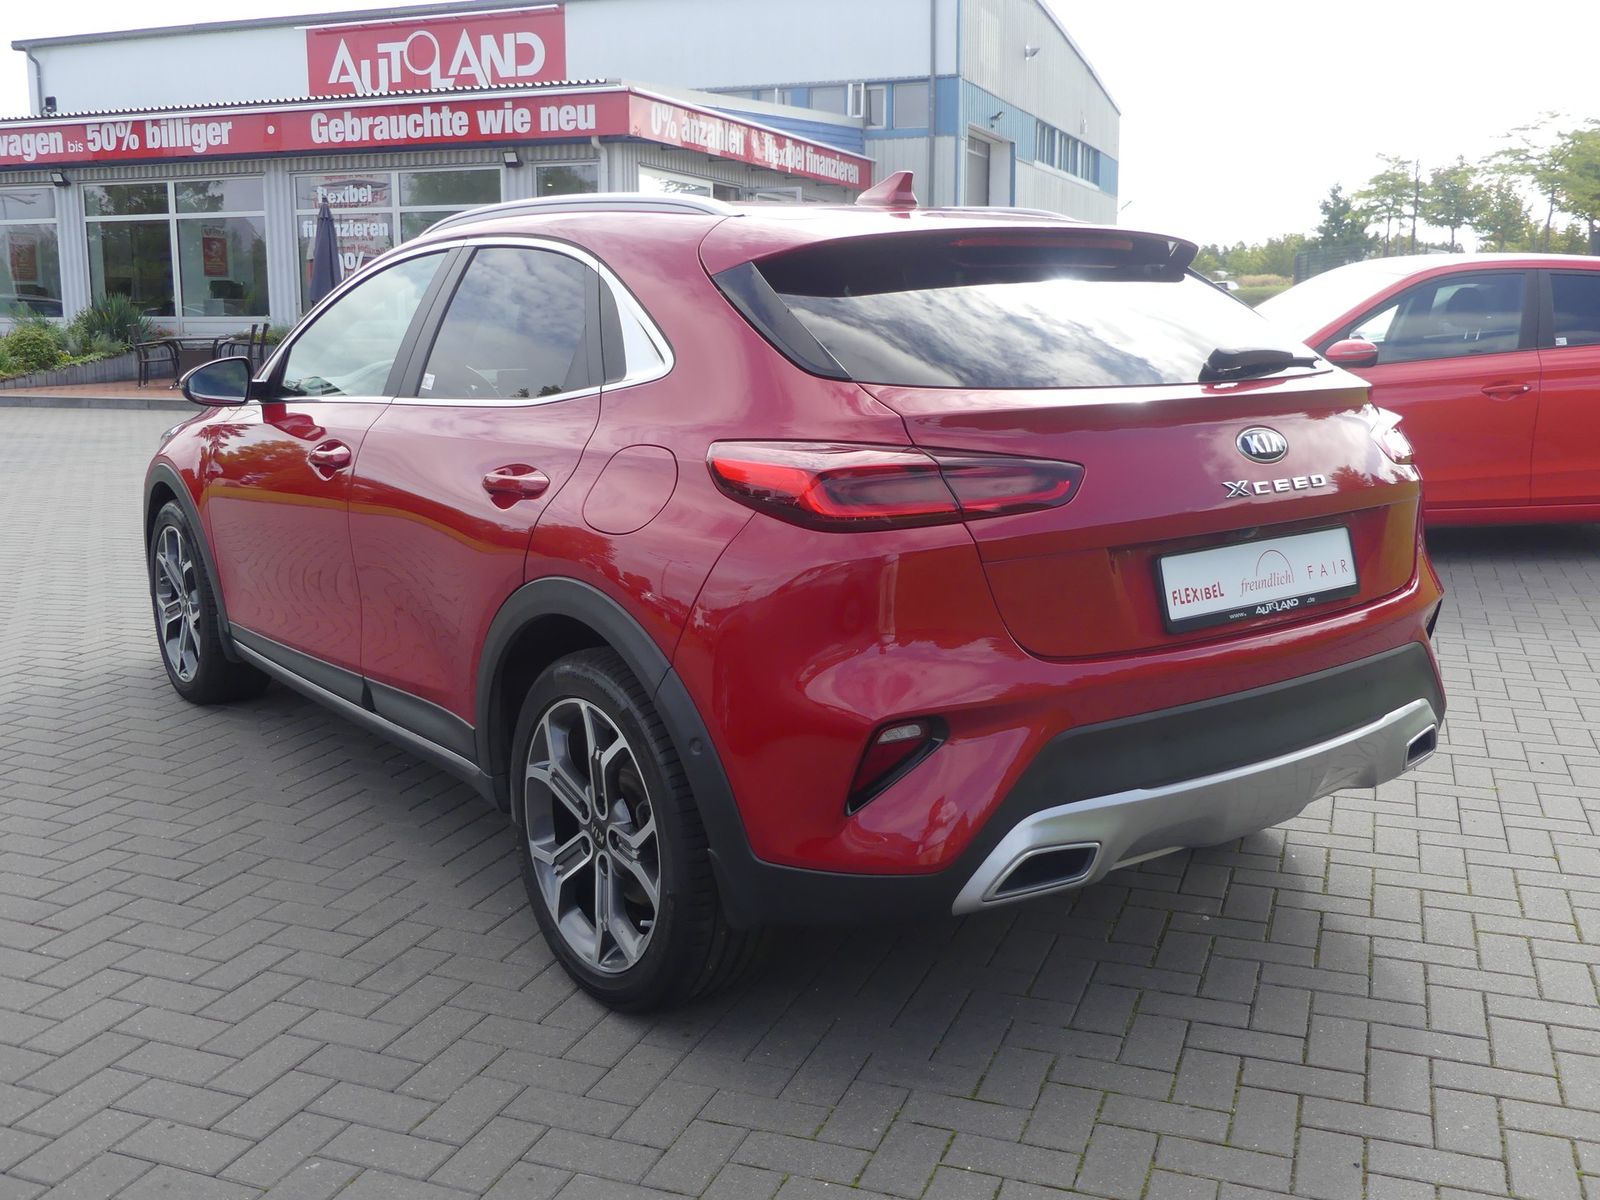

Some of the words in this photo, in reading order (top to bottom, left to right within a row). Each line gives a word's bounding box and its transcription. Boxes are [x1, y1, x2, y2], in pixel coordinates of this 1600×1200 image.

[328, 28, 546, 96] AUTOLAND
[68, 141, 84, 153] bis
[86, 120, 140, 152] 50%
[146, 117, 233, 153] billiger
[310, 104, 469, 144] Gebrauchte
[476, 101, 531, 135] wie
[540, 103, 597, 132] neu
[651, 102, 677, 140] 0%
[681, 114, 745, 156] anzahlen
[806, 145, 859, 185] finanzieren
[1244, 432, 1284, 455] KIA
[1221, 474, 1328, 499] XCEED
[1172, 582, 1225, 606] FLEXIBEL
[1240, 571, 1292, 598] freundlich
[1307, 559, 1348, 580] FAIR
[1255, 598, 1299, 615] AUTOLAND
